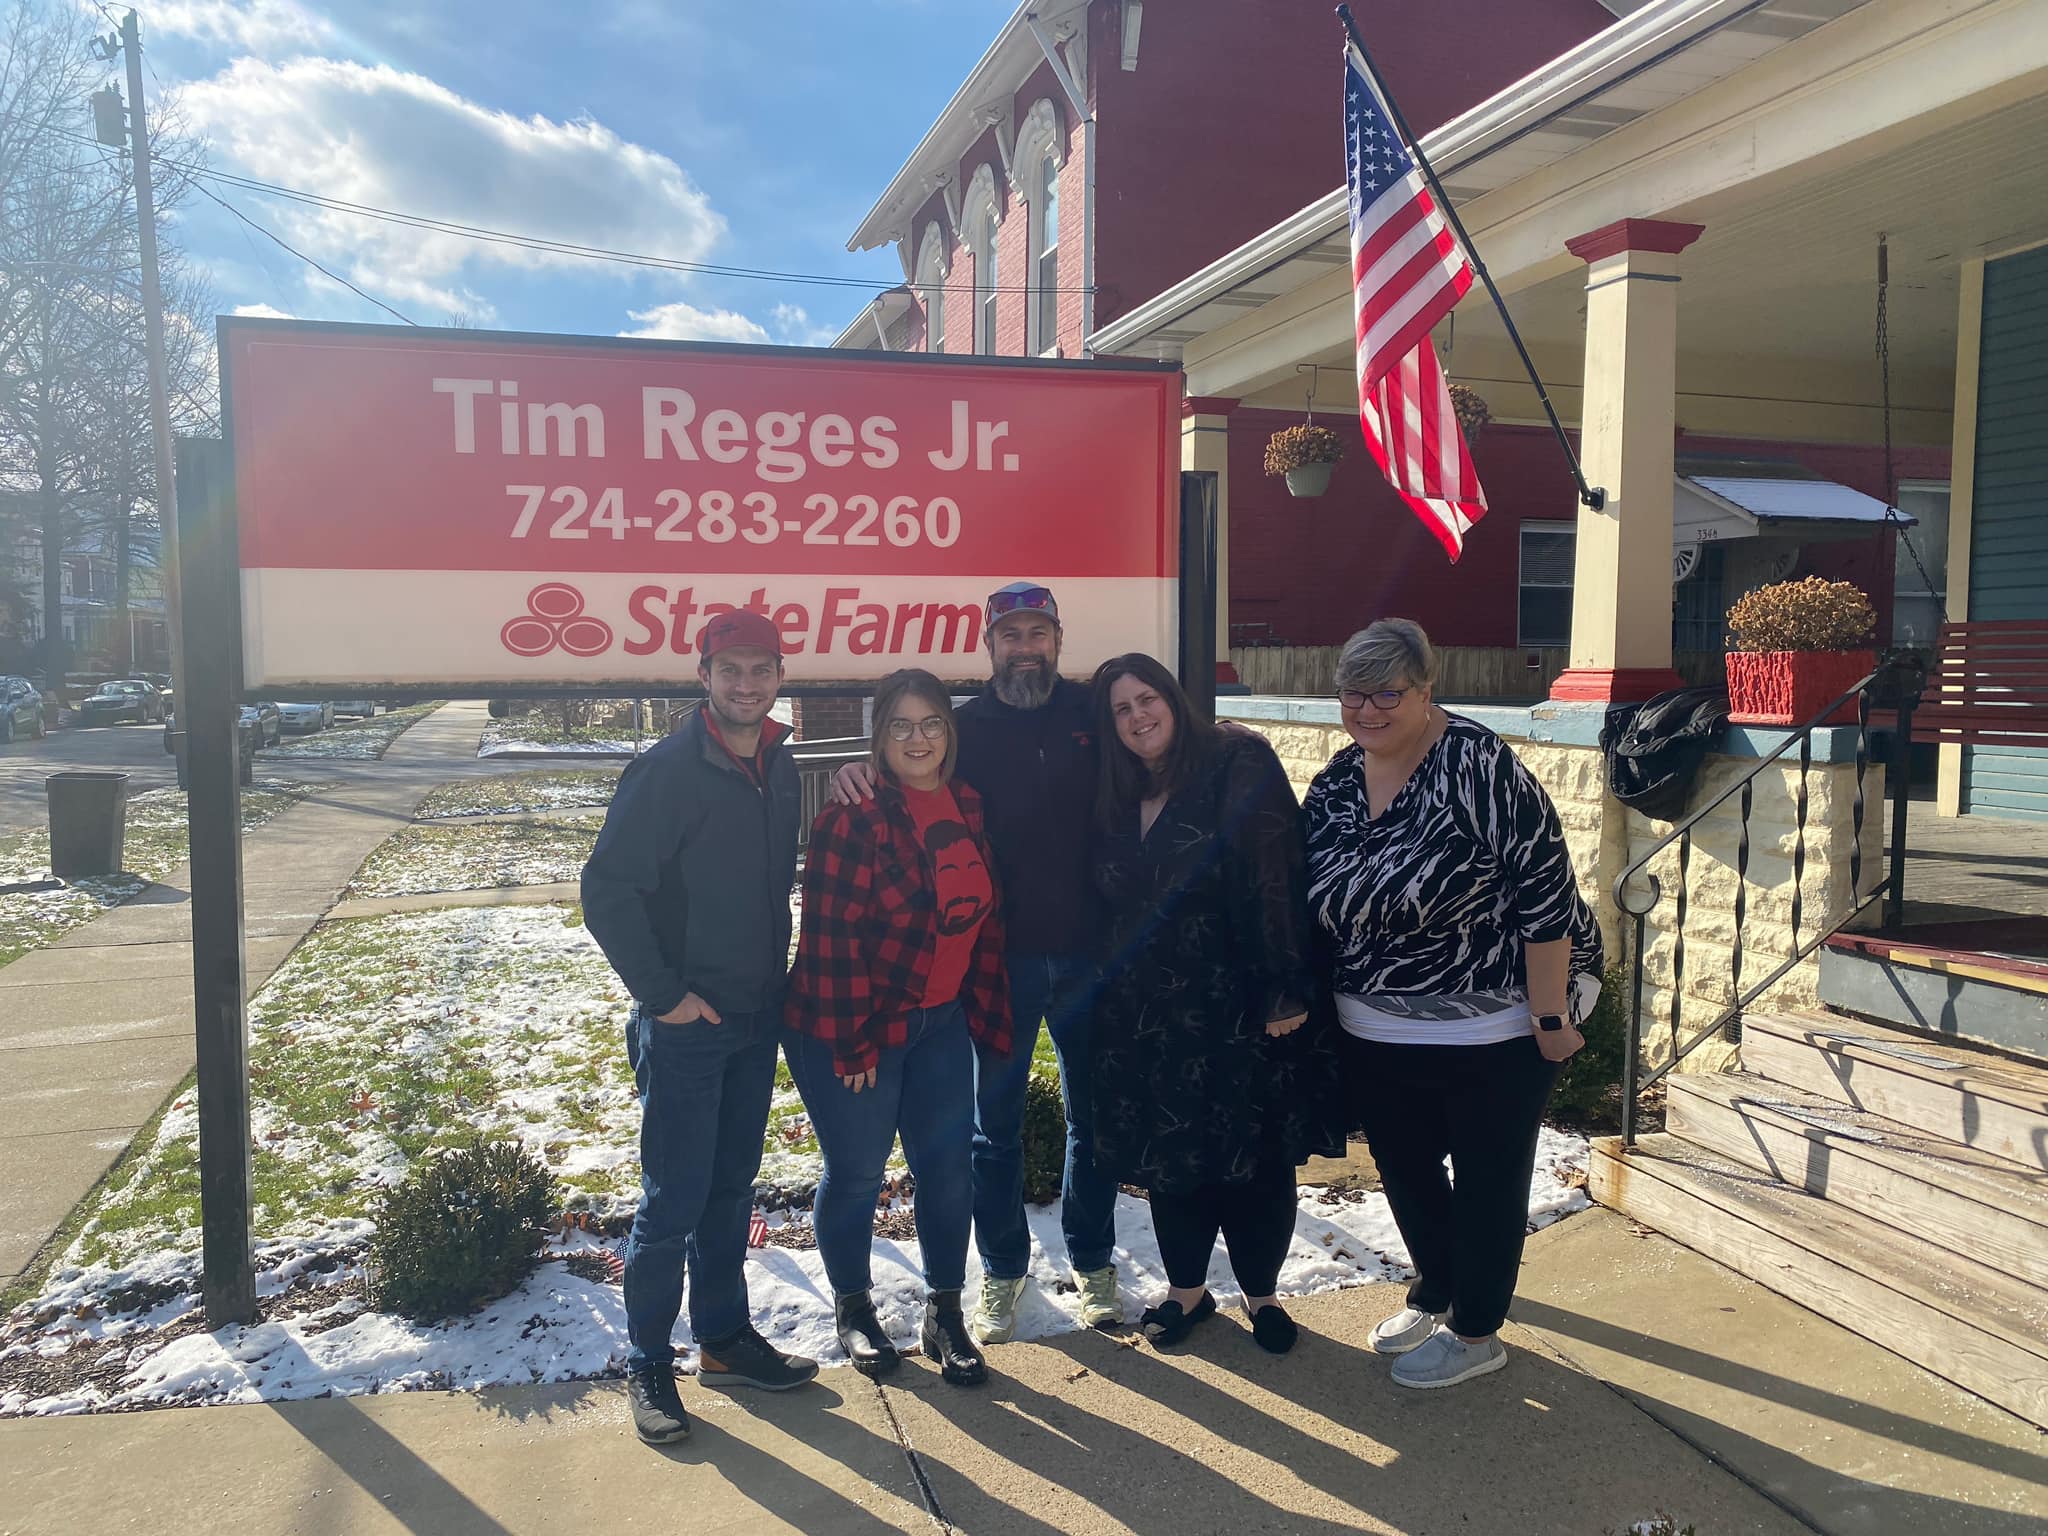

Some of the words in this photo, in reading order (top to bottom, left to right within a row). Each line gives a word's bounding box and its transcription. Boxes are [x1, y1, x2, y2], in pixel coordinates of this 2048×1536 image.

[431, 377, 607, 459] Tim
[642, 386, 901, 484] Reges
[928, 400, 1021, 472] Jr.
[505, 484, 962, 549] 724-283-2260
